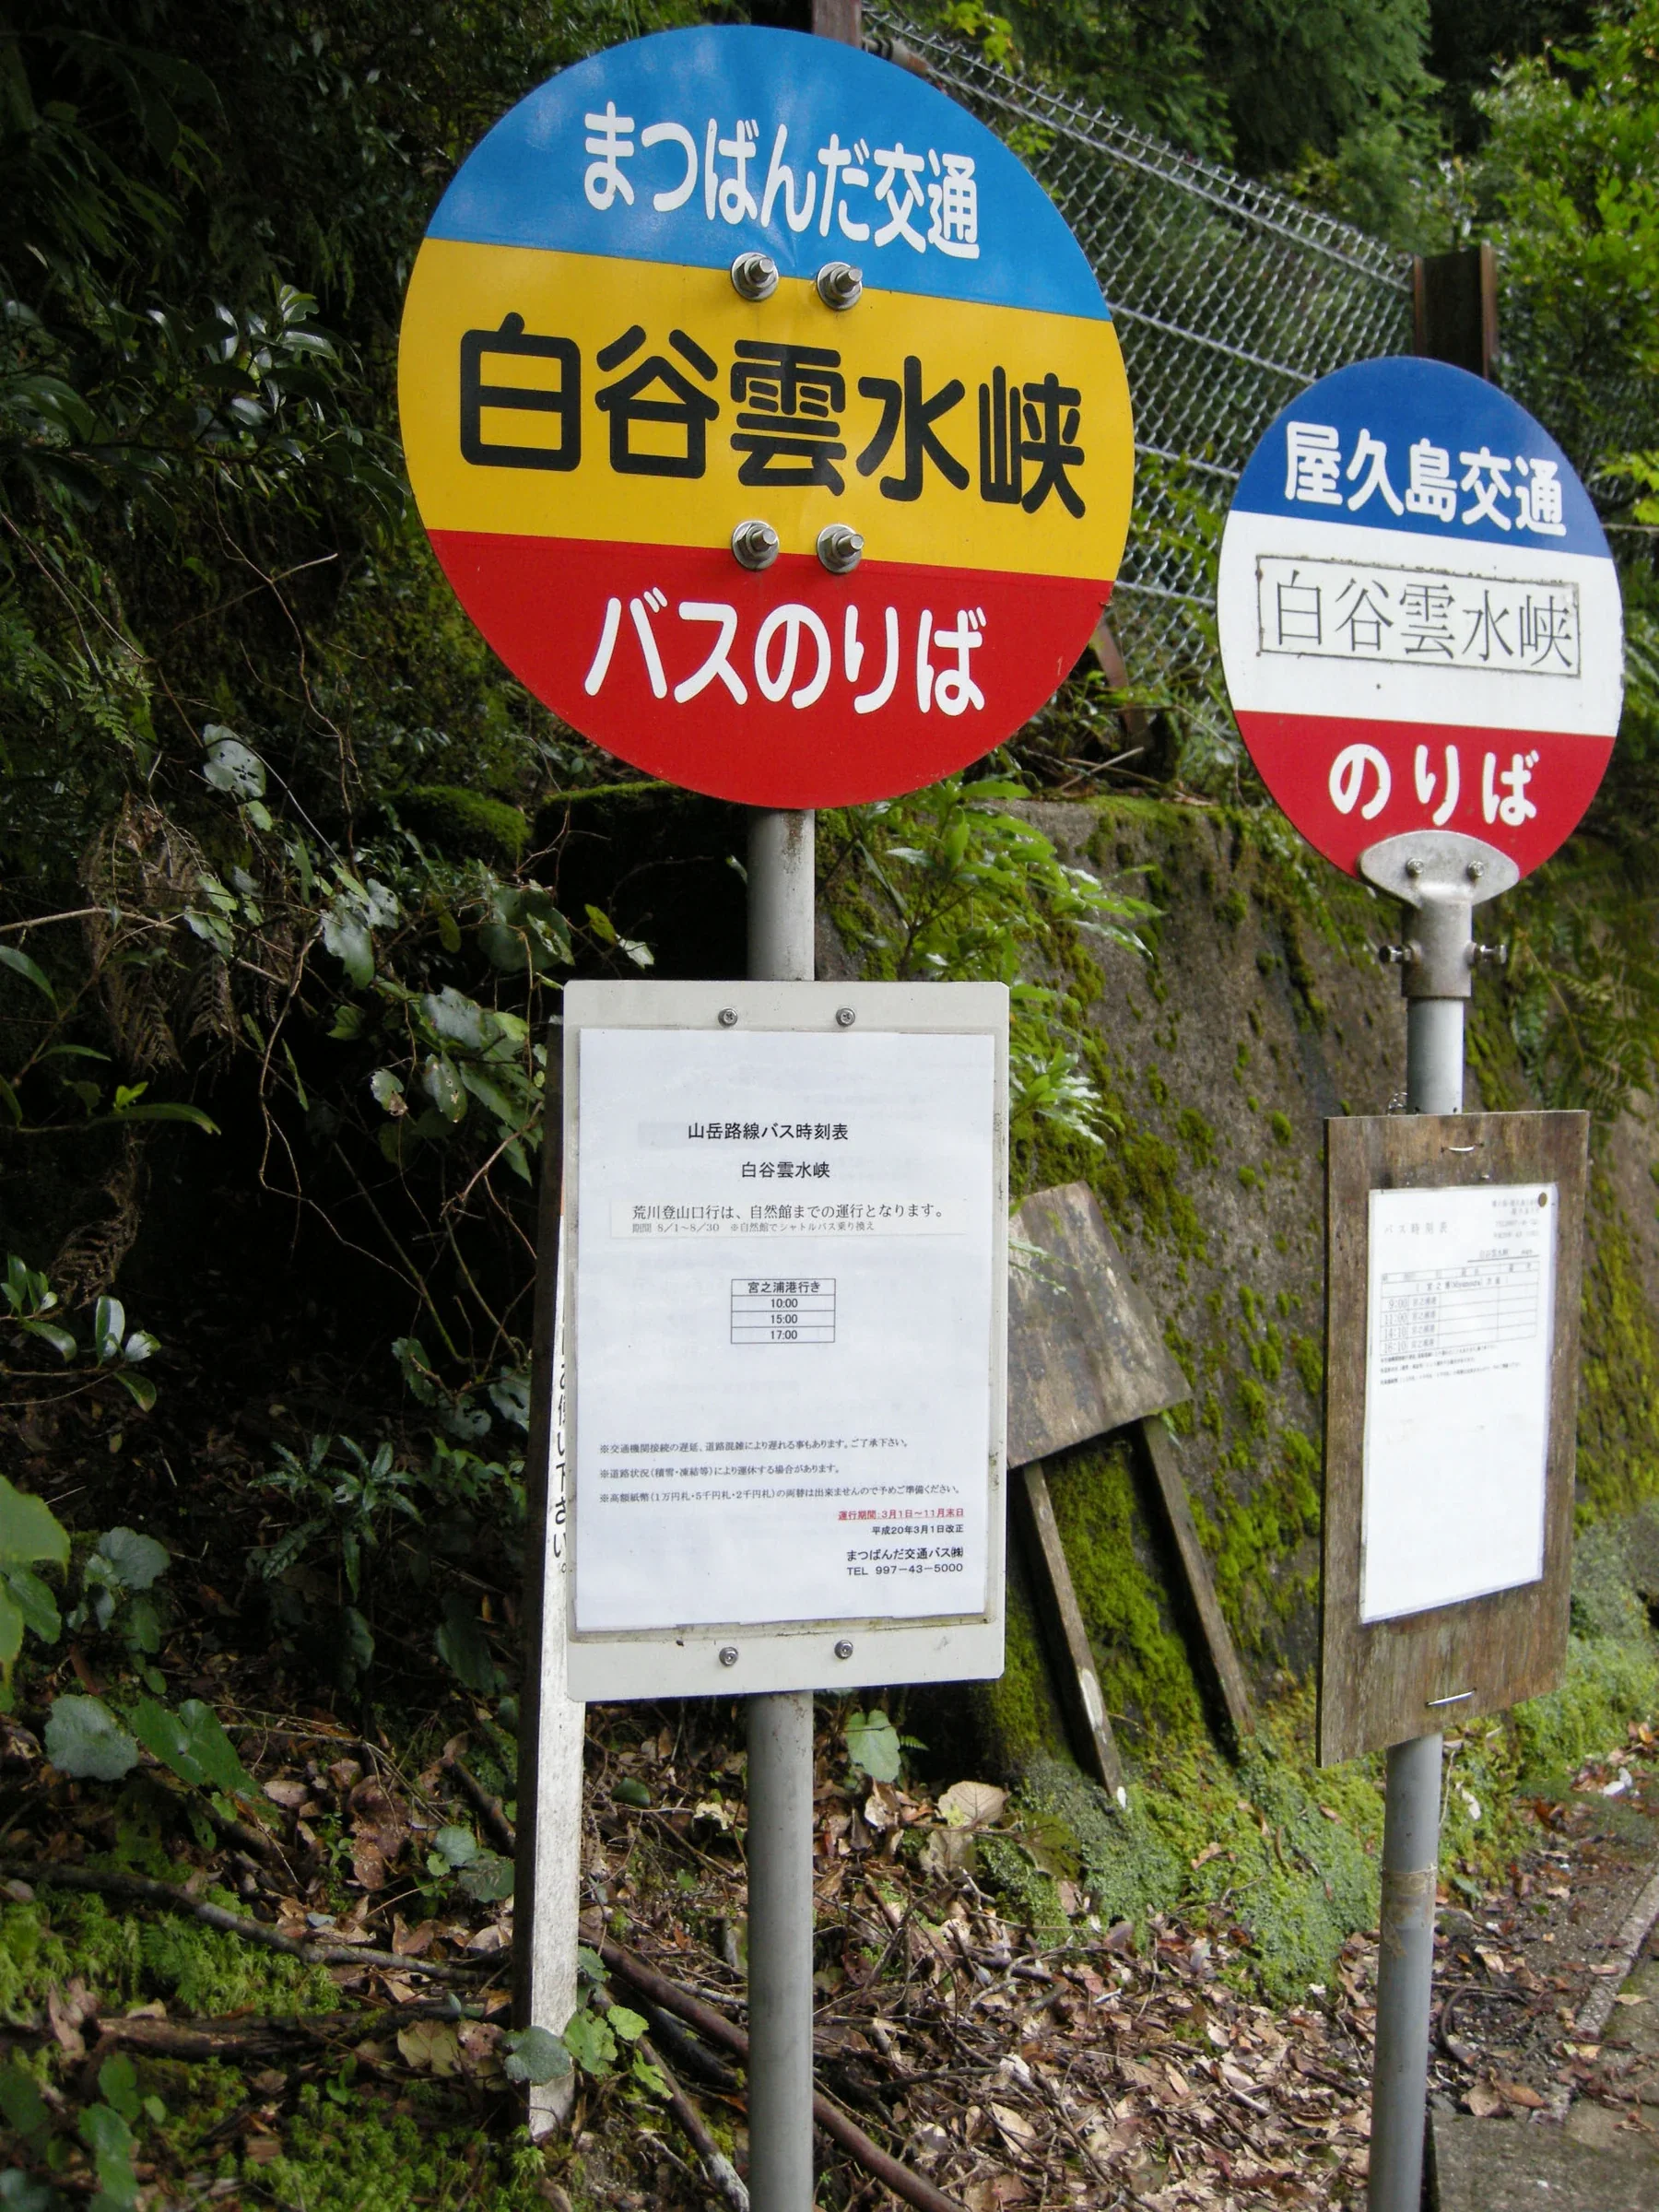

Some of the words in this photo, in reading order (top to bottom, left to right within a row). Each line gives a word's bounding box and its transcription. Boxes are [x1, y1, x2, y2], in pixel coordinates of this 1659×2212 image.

[583, 100, 981, 261] まつばんだ交通
[459, 312, 1087, 519] 白谷雲水峡
[1285, 420, 1568, 537] 屋久島交通
[1276, 569, 1573, 668] 白谷雲水峡
[584, 586, 987, 716] バスのりば
[1328, 743, 1540, 827] のりば
[688, 1122, 849, 1141] 山岳路線バス時刻表
[741, 1161, 830, 1179] 白谷雲水峡
[631, 1202, 943, 1220] 荒川登山口行は、自然館までの運行となります。
[747, 1279, 820, 1294] 宮之浦港行き
[771, 1298, 798, 1309] 10:00
[771, 1313, 798, 1324] 15:00
[771, 1329, 798, 1340] 17:00
[872, 1524, 964, 1535] 平成20年3月1日改正
[846, 1566, 869, 1576] TEL
